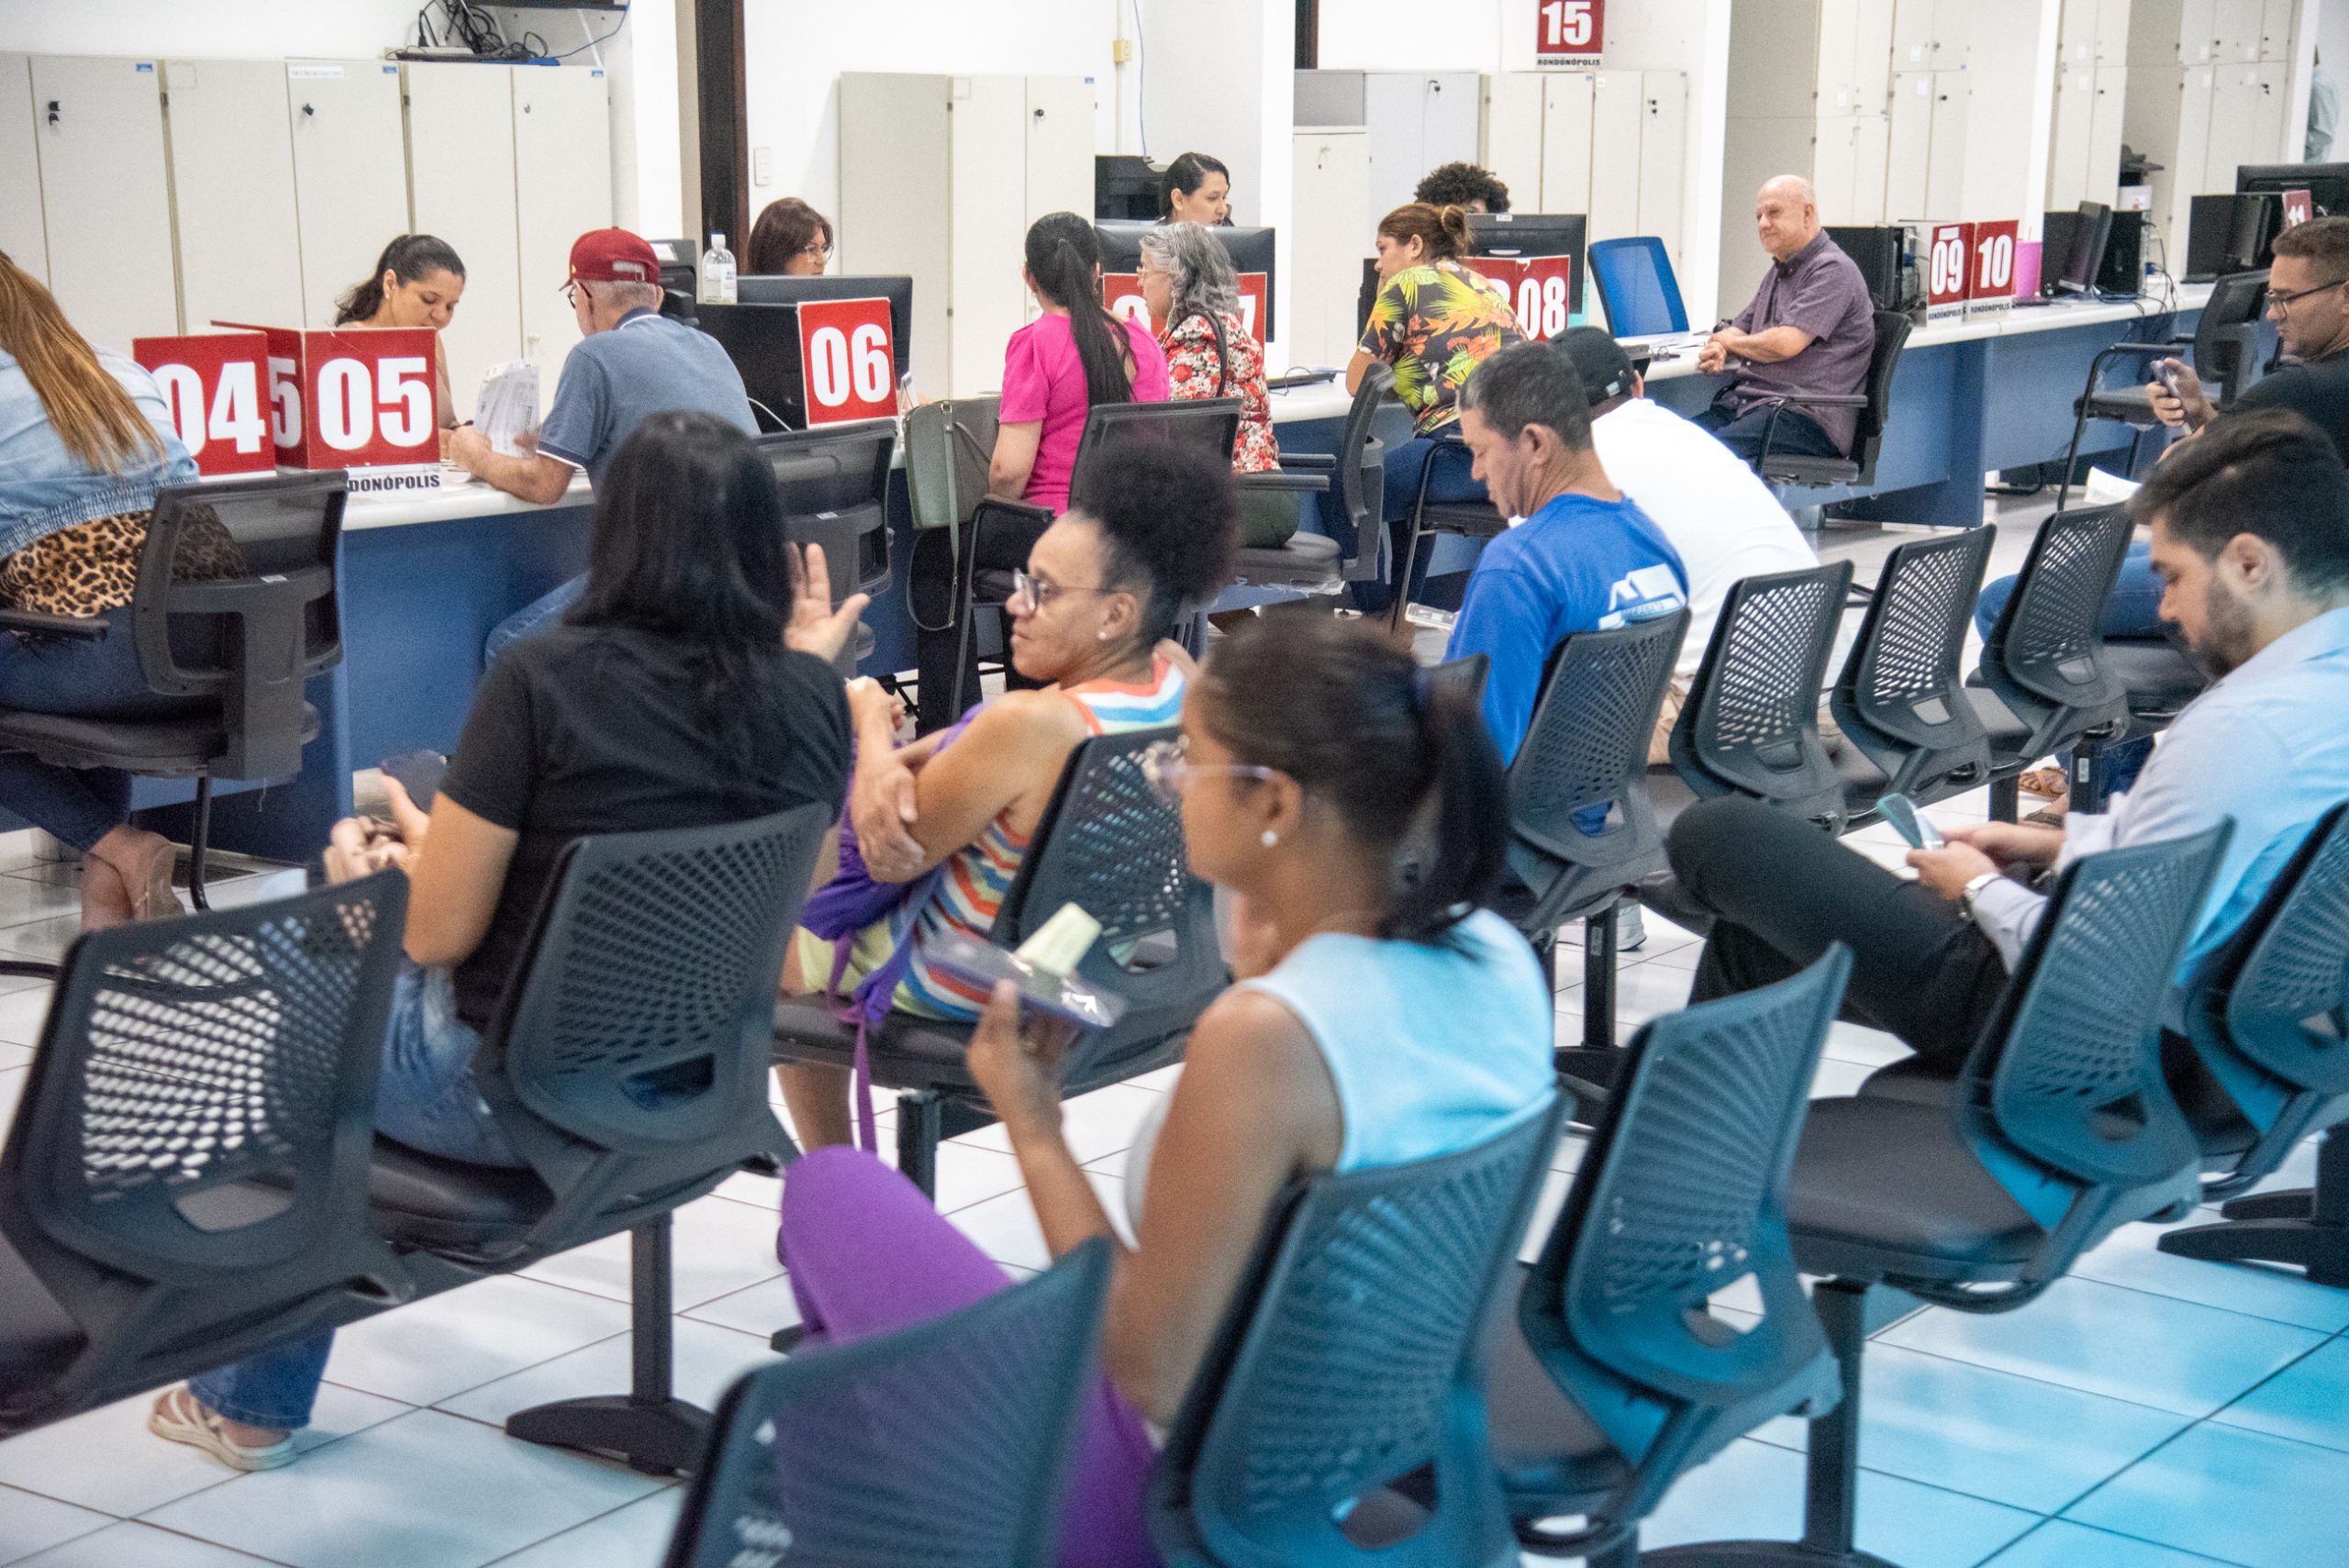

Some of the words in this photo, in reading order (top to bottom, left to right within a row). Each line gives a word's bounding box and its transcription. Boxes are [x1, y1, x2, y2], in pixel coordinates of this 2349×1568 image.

[1542, 1, 1592, 45] 15
[1931, 239, 1964, 295] 09
[1978, 234, 2012, 289] 10
[1518, 276, 1565, 340] 08
[810, 323, 891, 406] 06
[151, 361, 266, 457] 04
[268, 357, 302, 449] 5
[317, 357, 432, 450] 05
[349, 475, 440, 492] DONÓPOLIS
